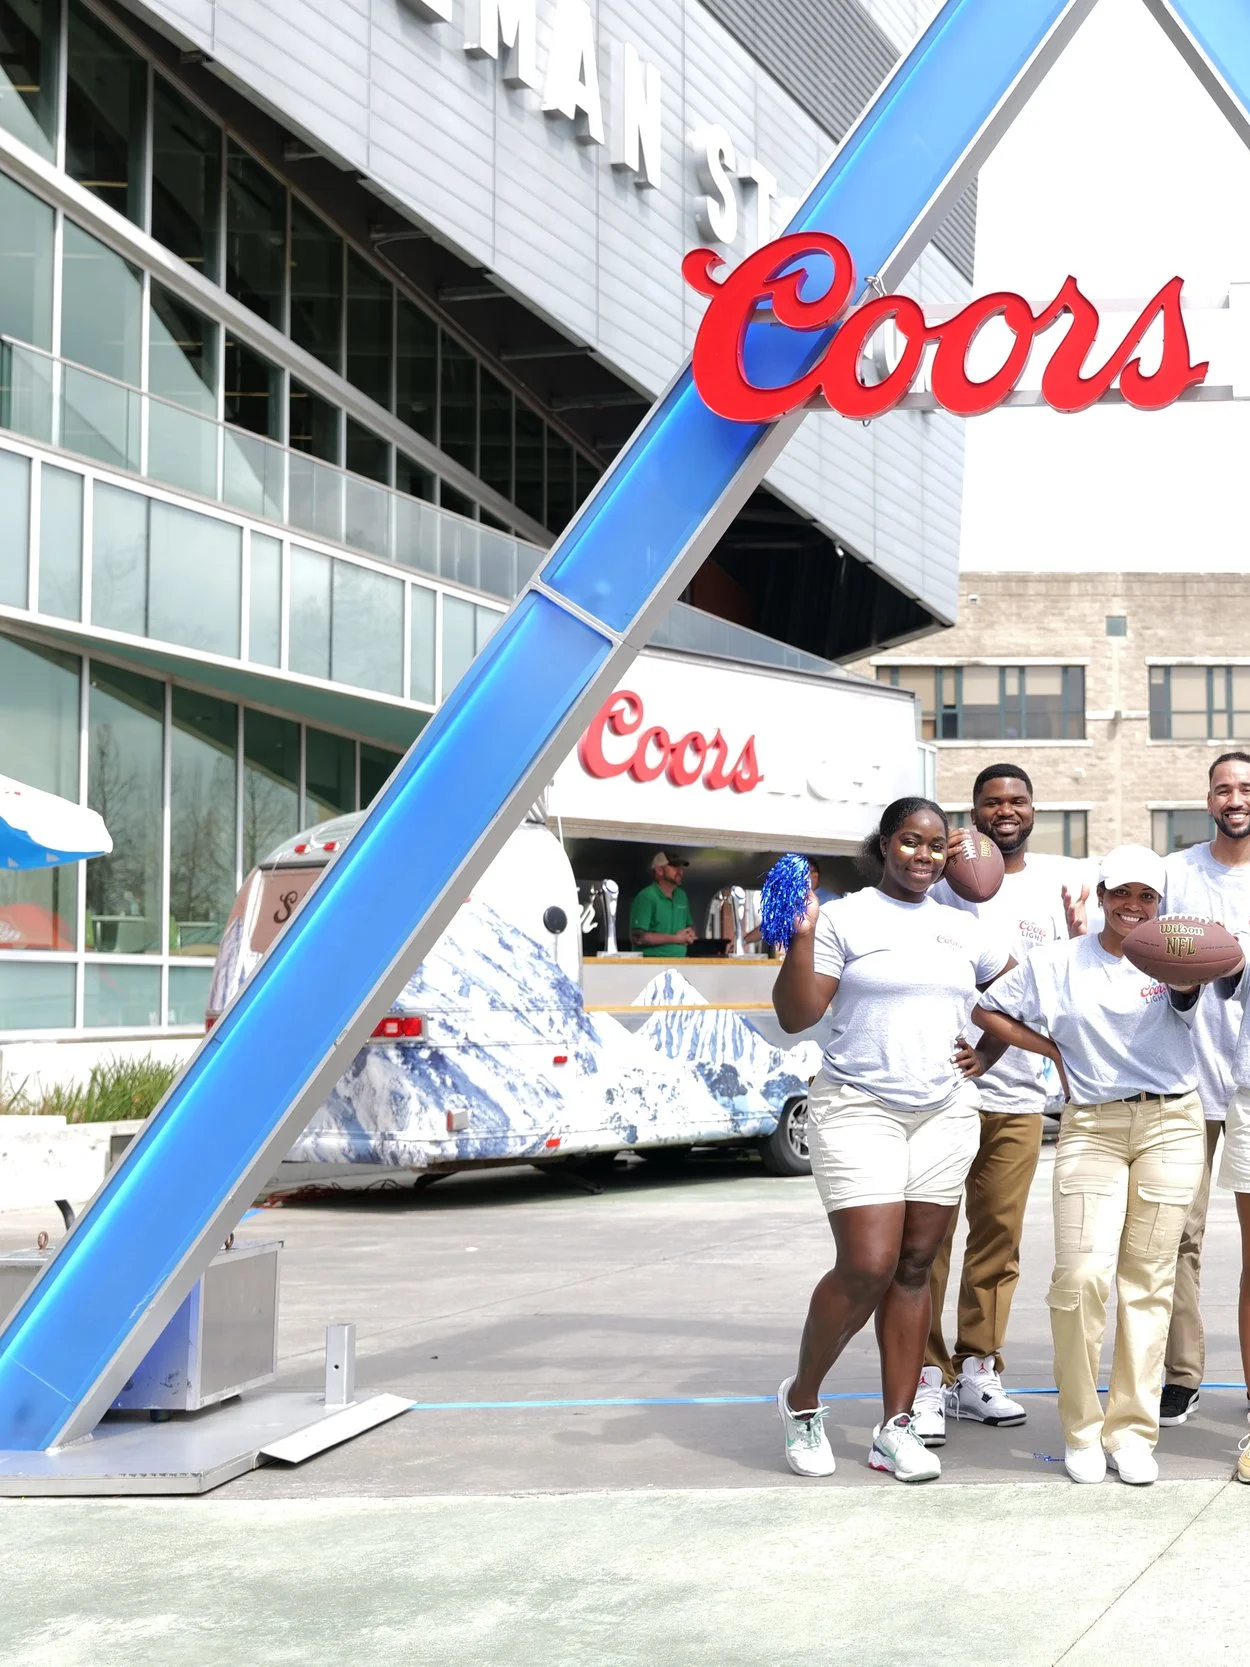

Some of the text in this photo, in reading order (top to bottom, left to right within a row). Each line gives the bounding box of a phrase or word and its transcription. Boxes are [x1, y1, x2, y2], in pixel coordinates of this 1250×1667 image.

[682, 231, 1210, 424] Coors
[577, 689, 765, 794] Coors
[1160, 923, 1204, 936] Wilson
[1164, 936, 1196, 958] NFL
